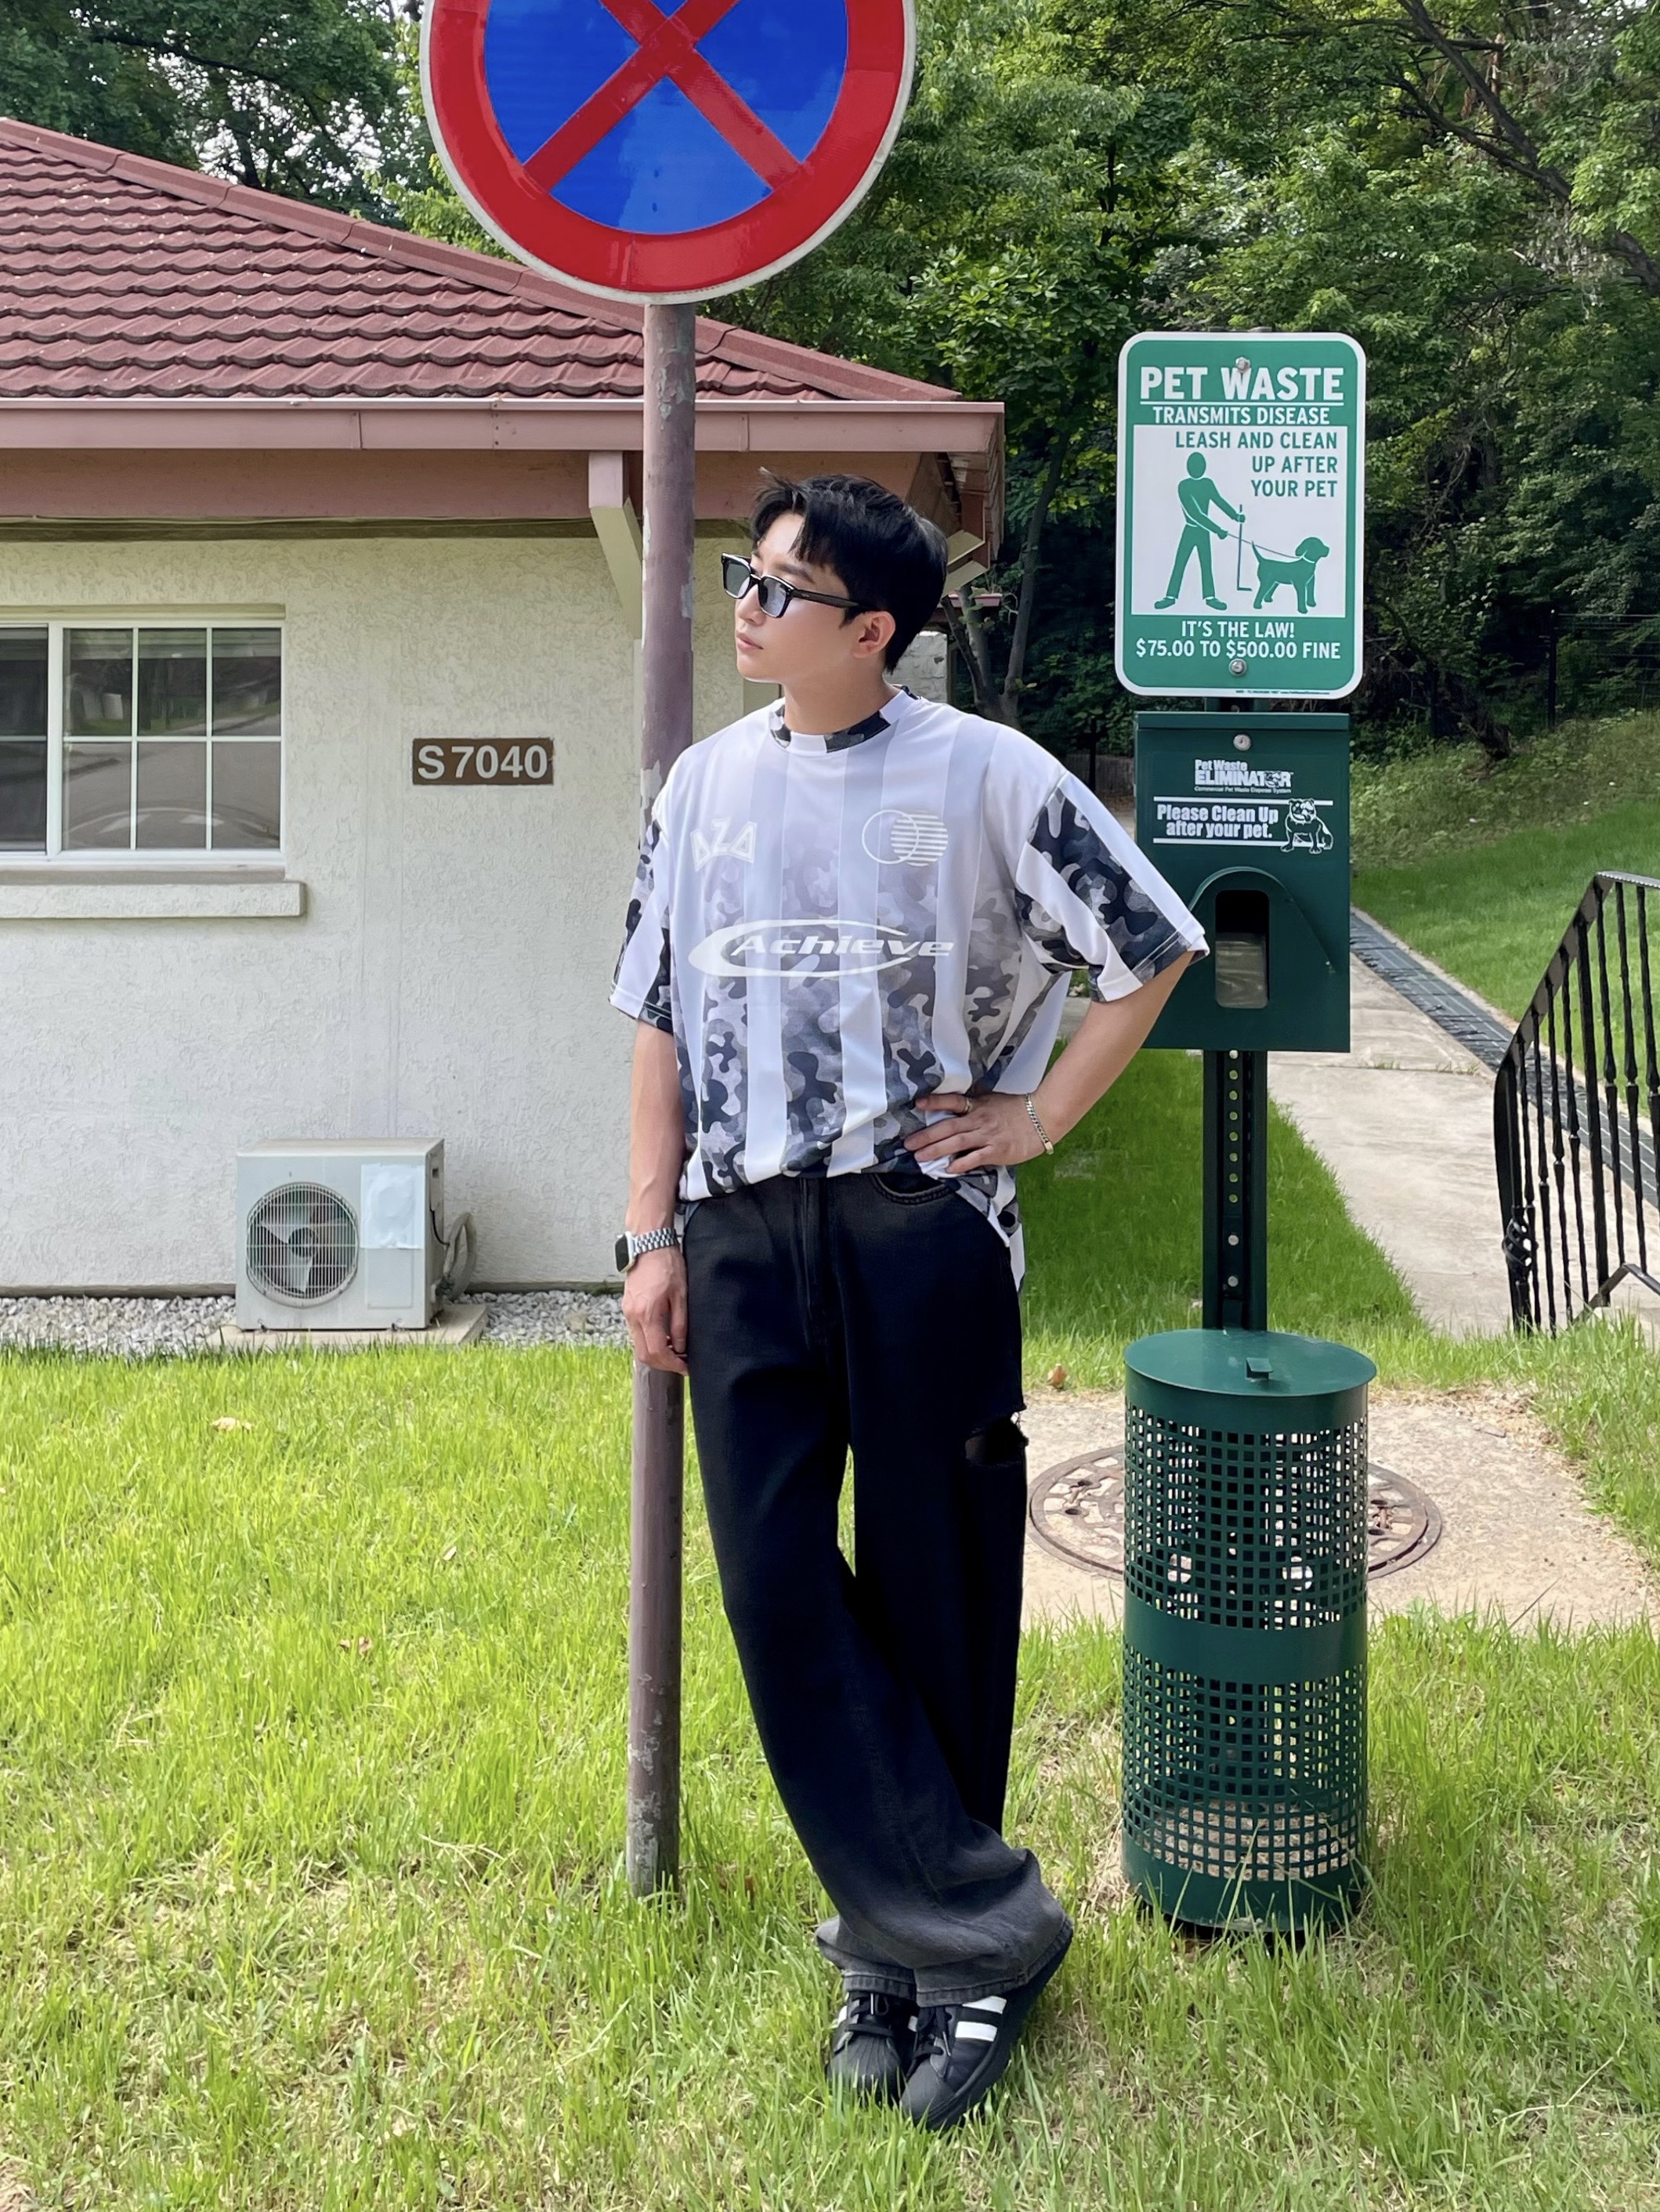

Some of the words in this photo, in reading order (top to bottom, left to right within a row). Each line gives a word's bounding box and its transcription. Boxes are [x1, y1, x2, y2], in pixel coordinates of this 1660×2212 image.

[1141, 366, 1208, 400] PET
[1221, 367, 1344, 402] WASTE
[1152, 406, 1251, 425] TRANSMITS
[1257, 407, 1330, 425] DISEASE
[1175, 431, 1231, 449] LEASH
[1237, 432, 1274, 449] AND
[1279, 432, 1338, 450] CLEAN
[1252, 455, 1275, 473] UP
[1281, 456, 1338, 474] AFTER
[1250, 479, 1298, 497] YOUR
[1304, 479, 1338, 498] PET
[1181, 620, 1213, 638] IT'S
[1217, 621, 1250, 638] THE
[1255, 622, 1295, 638] LAW!
[1136, 638, 1195, 658] $75.00
[1199, 640, 1221, 657] TO
[1225, 640, 1297, 660] $500.00
[1303, 642, 1341, 660] FINE
[418, 744, 446, 779] S
[451, 744, 548, 779] 7040
[1194, 759, 1213, 771] Pet
[1213, 759, 1248, 772] Waste
[1156, 804, 1208, 822] Please
[1211, 805, 1256, 822] Clean
[1258, 807, 1279, 825] Up
[1166, 820, 1203, 837] after
[1205, 822, 1241, 838] your
[1242, 822, 1274, 840] pet.
[729, 934, 954, 957] Achieve
